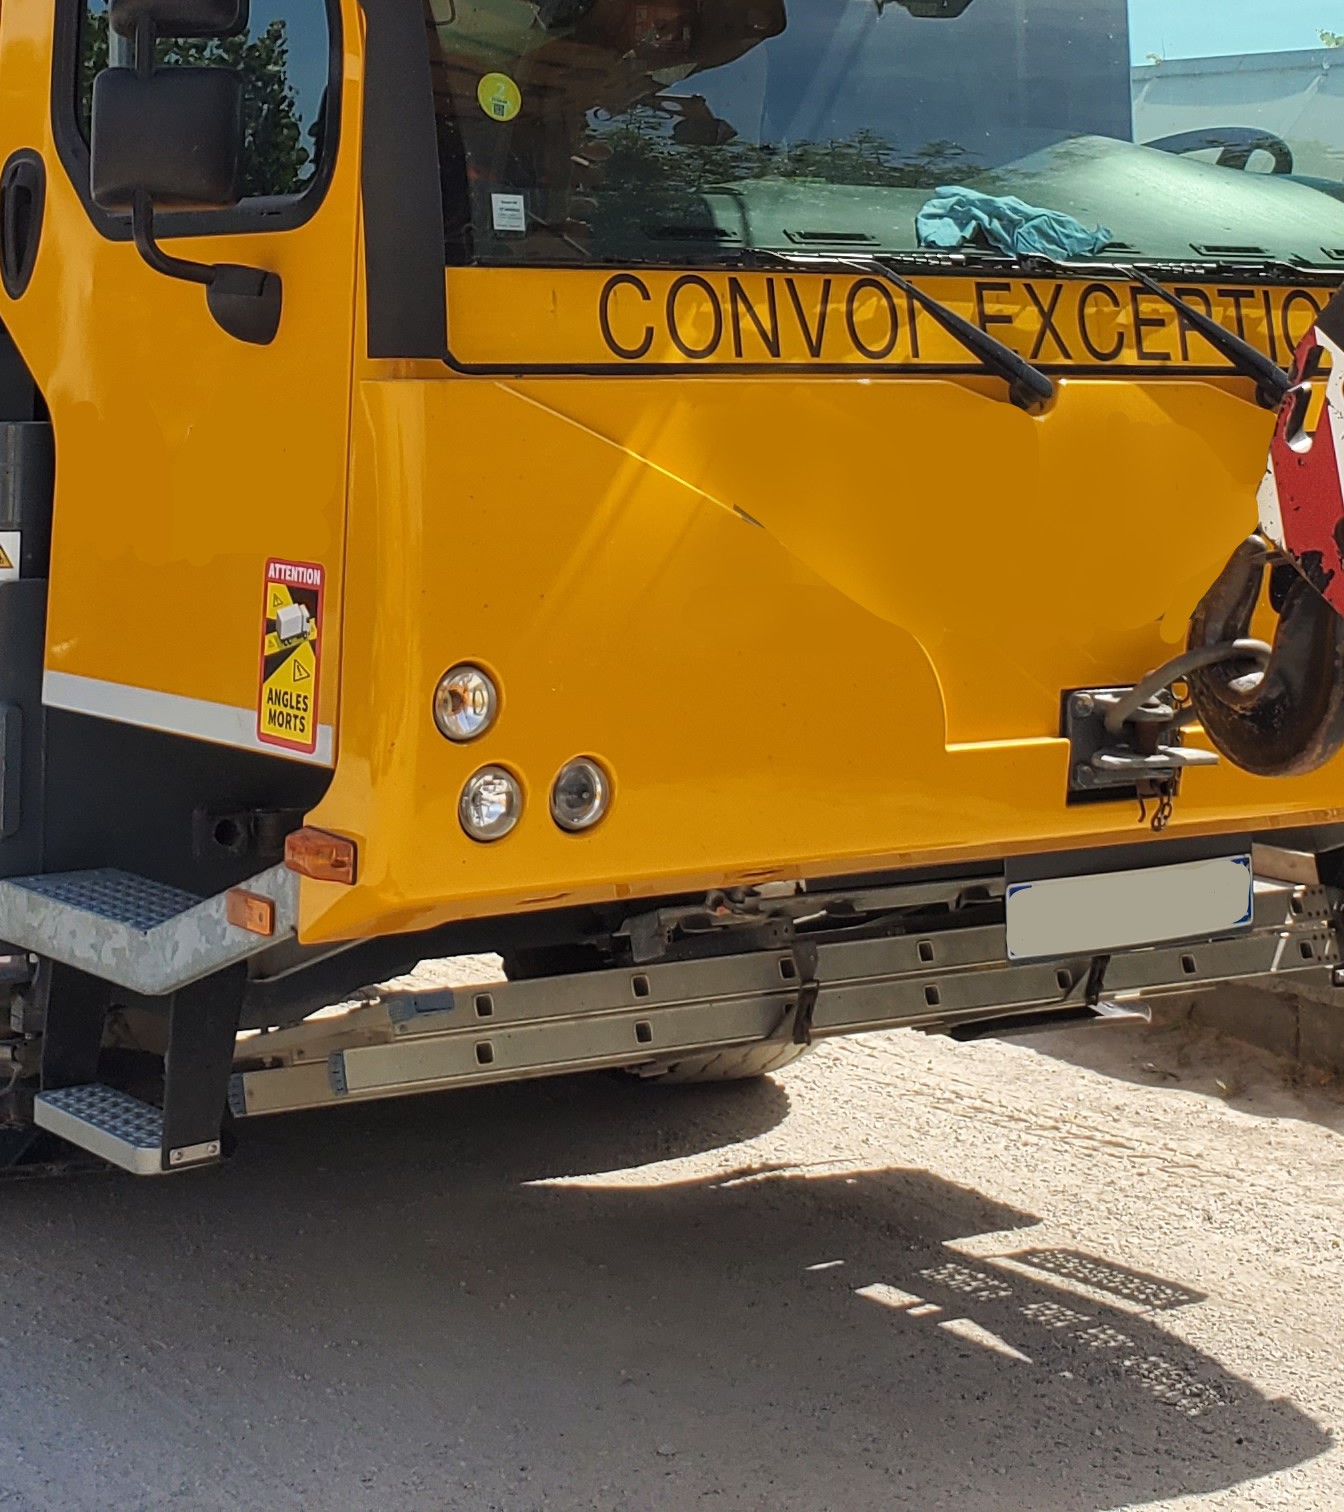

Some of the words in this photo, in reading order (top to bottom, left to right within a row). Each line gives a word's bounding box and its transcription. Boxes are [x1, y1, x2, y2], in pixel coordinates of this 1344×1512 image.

[599, 273, 920, 362] CONVOI
[973, 280, 1335, 364] EXCEPTIO
[268, 562, 321, 586] ATTENTION
[267, 687, 309, 713] ANGLES
[268, 708, 306, 733] MORTS
